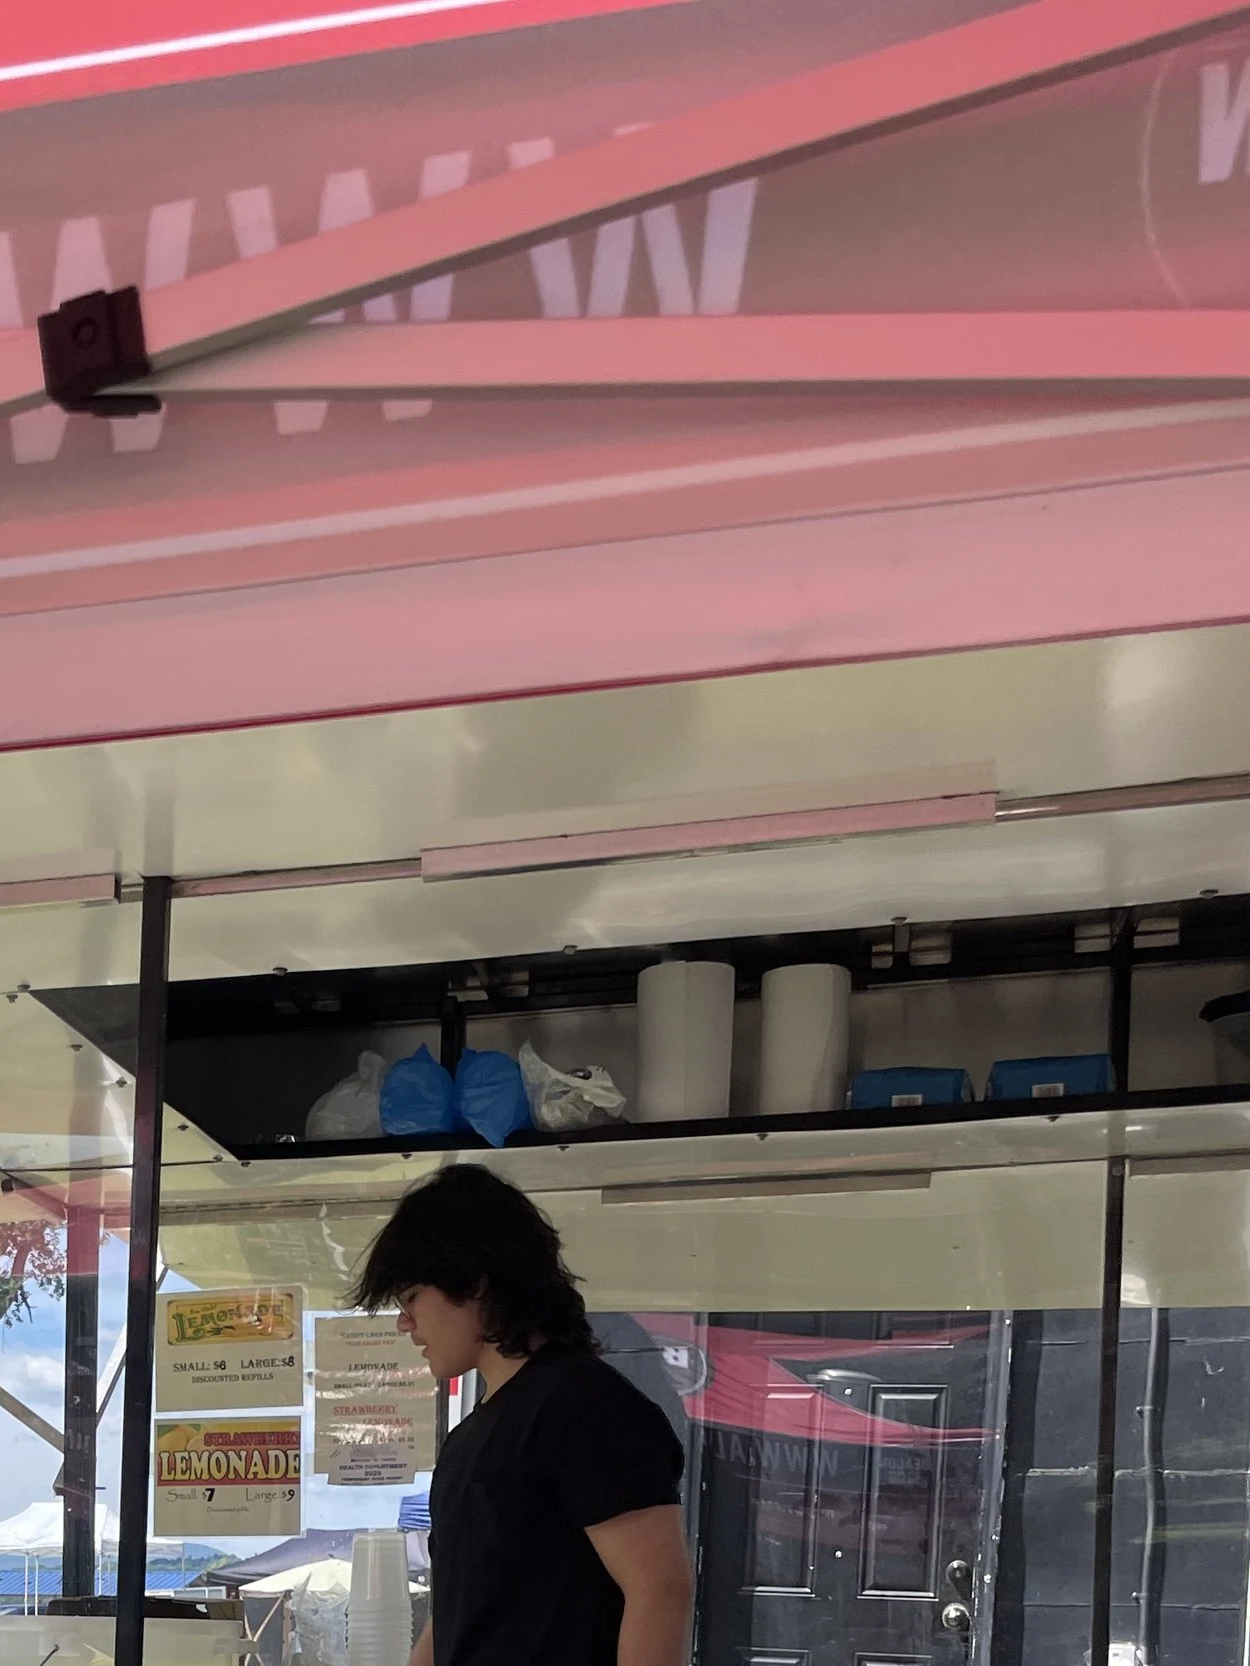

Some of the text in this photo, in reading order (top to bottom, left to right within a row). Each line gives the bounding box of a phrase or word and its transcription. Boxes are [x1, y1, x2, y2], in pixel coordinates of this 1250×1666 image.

[348, 1362, 399, 1372] LEMONADE
[191, 1372, 274, 1384] DISCOUNTED REFILLS
[333, 1403, 399, 1416] STRAWBERRY
[159, 1449, 300, 1481] LEMONADE
